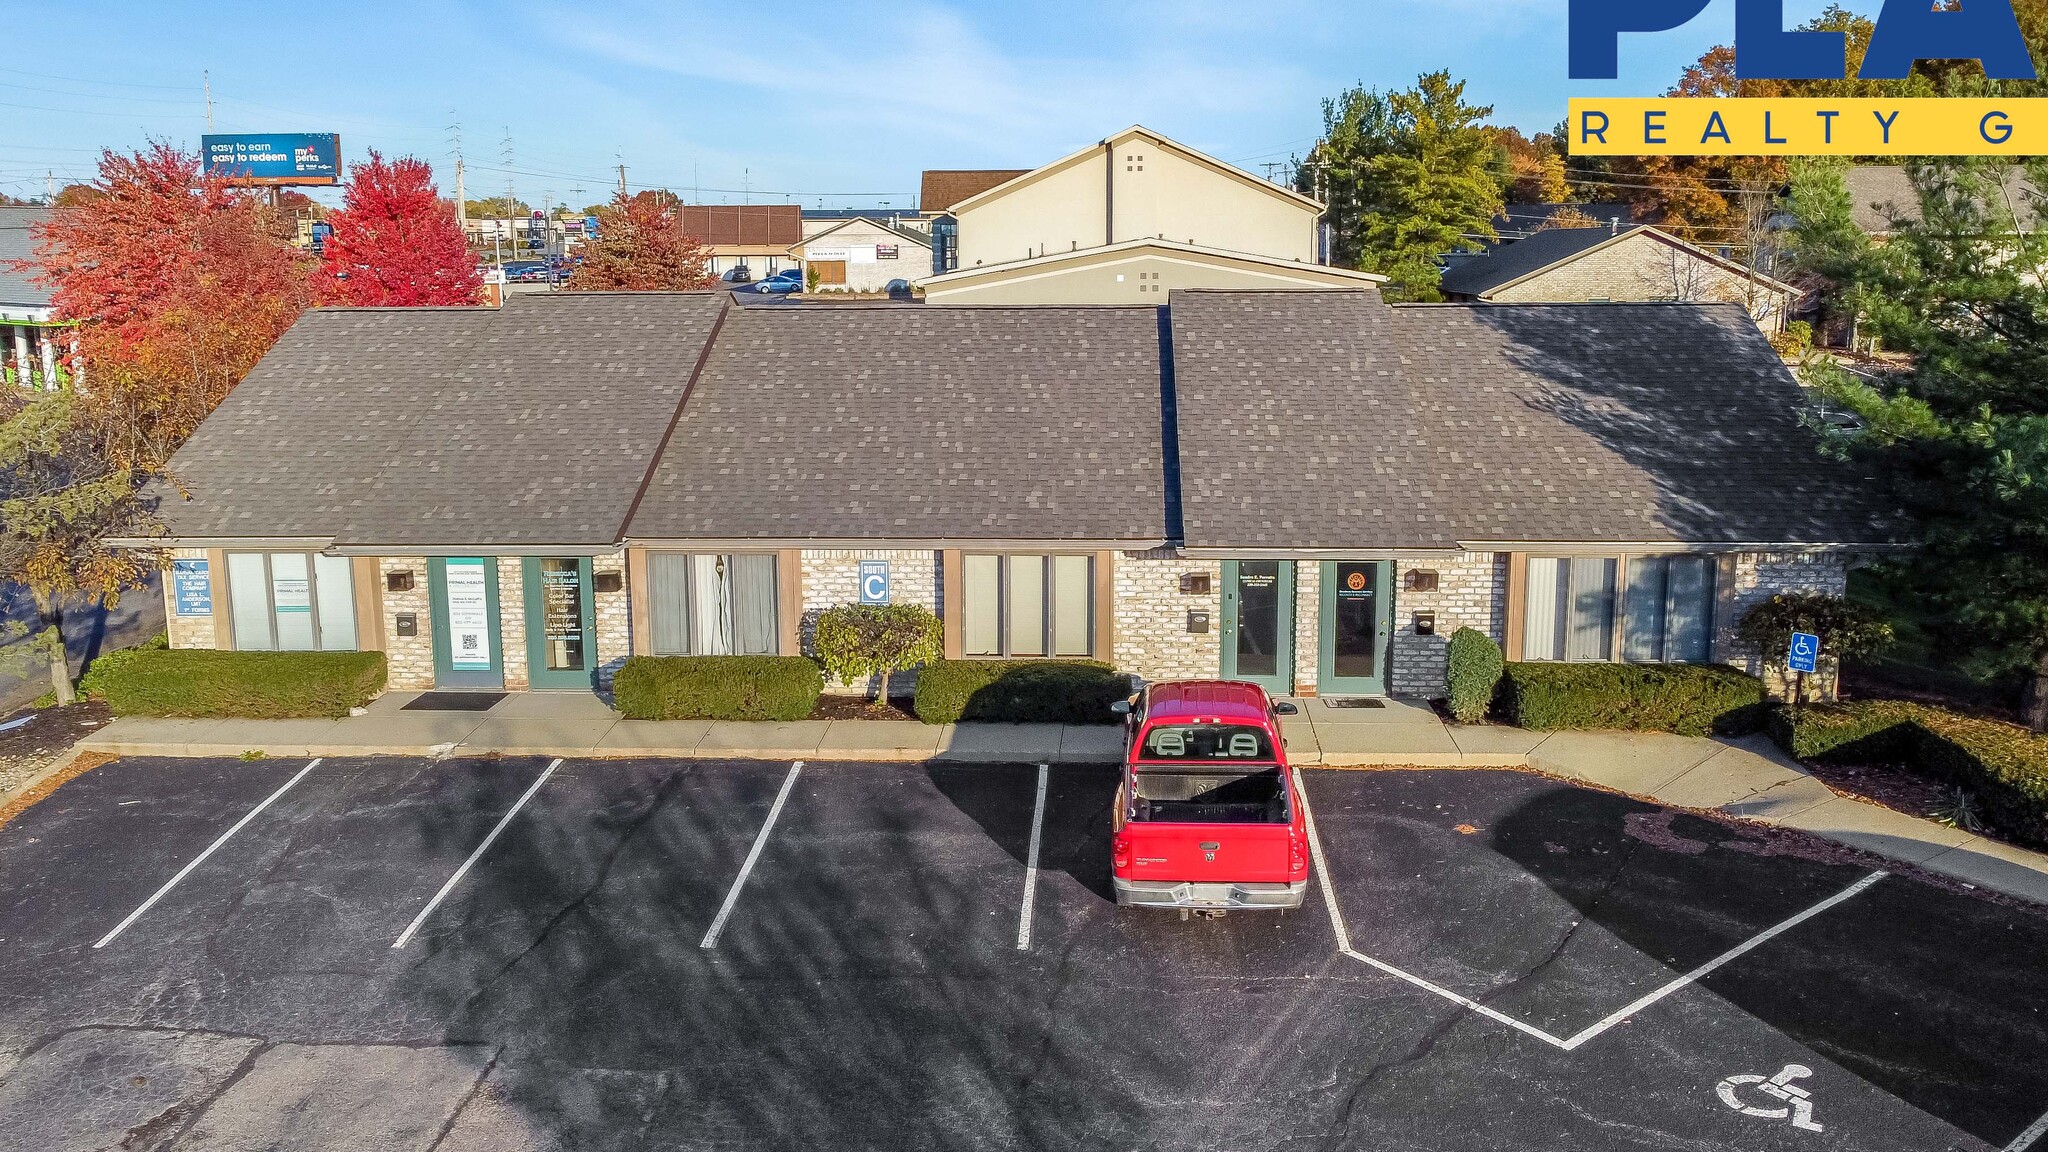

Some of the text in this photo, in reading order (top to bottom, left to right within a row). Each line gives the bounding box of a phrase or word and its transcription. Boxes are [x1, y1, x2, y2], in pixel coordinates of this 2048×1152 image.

[211, 143, 271, 153] easy to earn
[294, 148, 308, 156] my
[212, 153, 288, 163] easy to redeem
[295, 154, 320, 163] perks
[864, 565, 885, 574] SOUTH
[864, 575, 885, 599] C
[1792, 655, 1813, 664] PARKING
